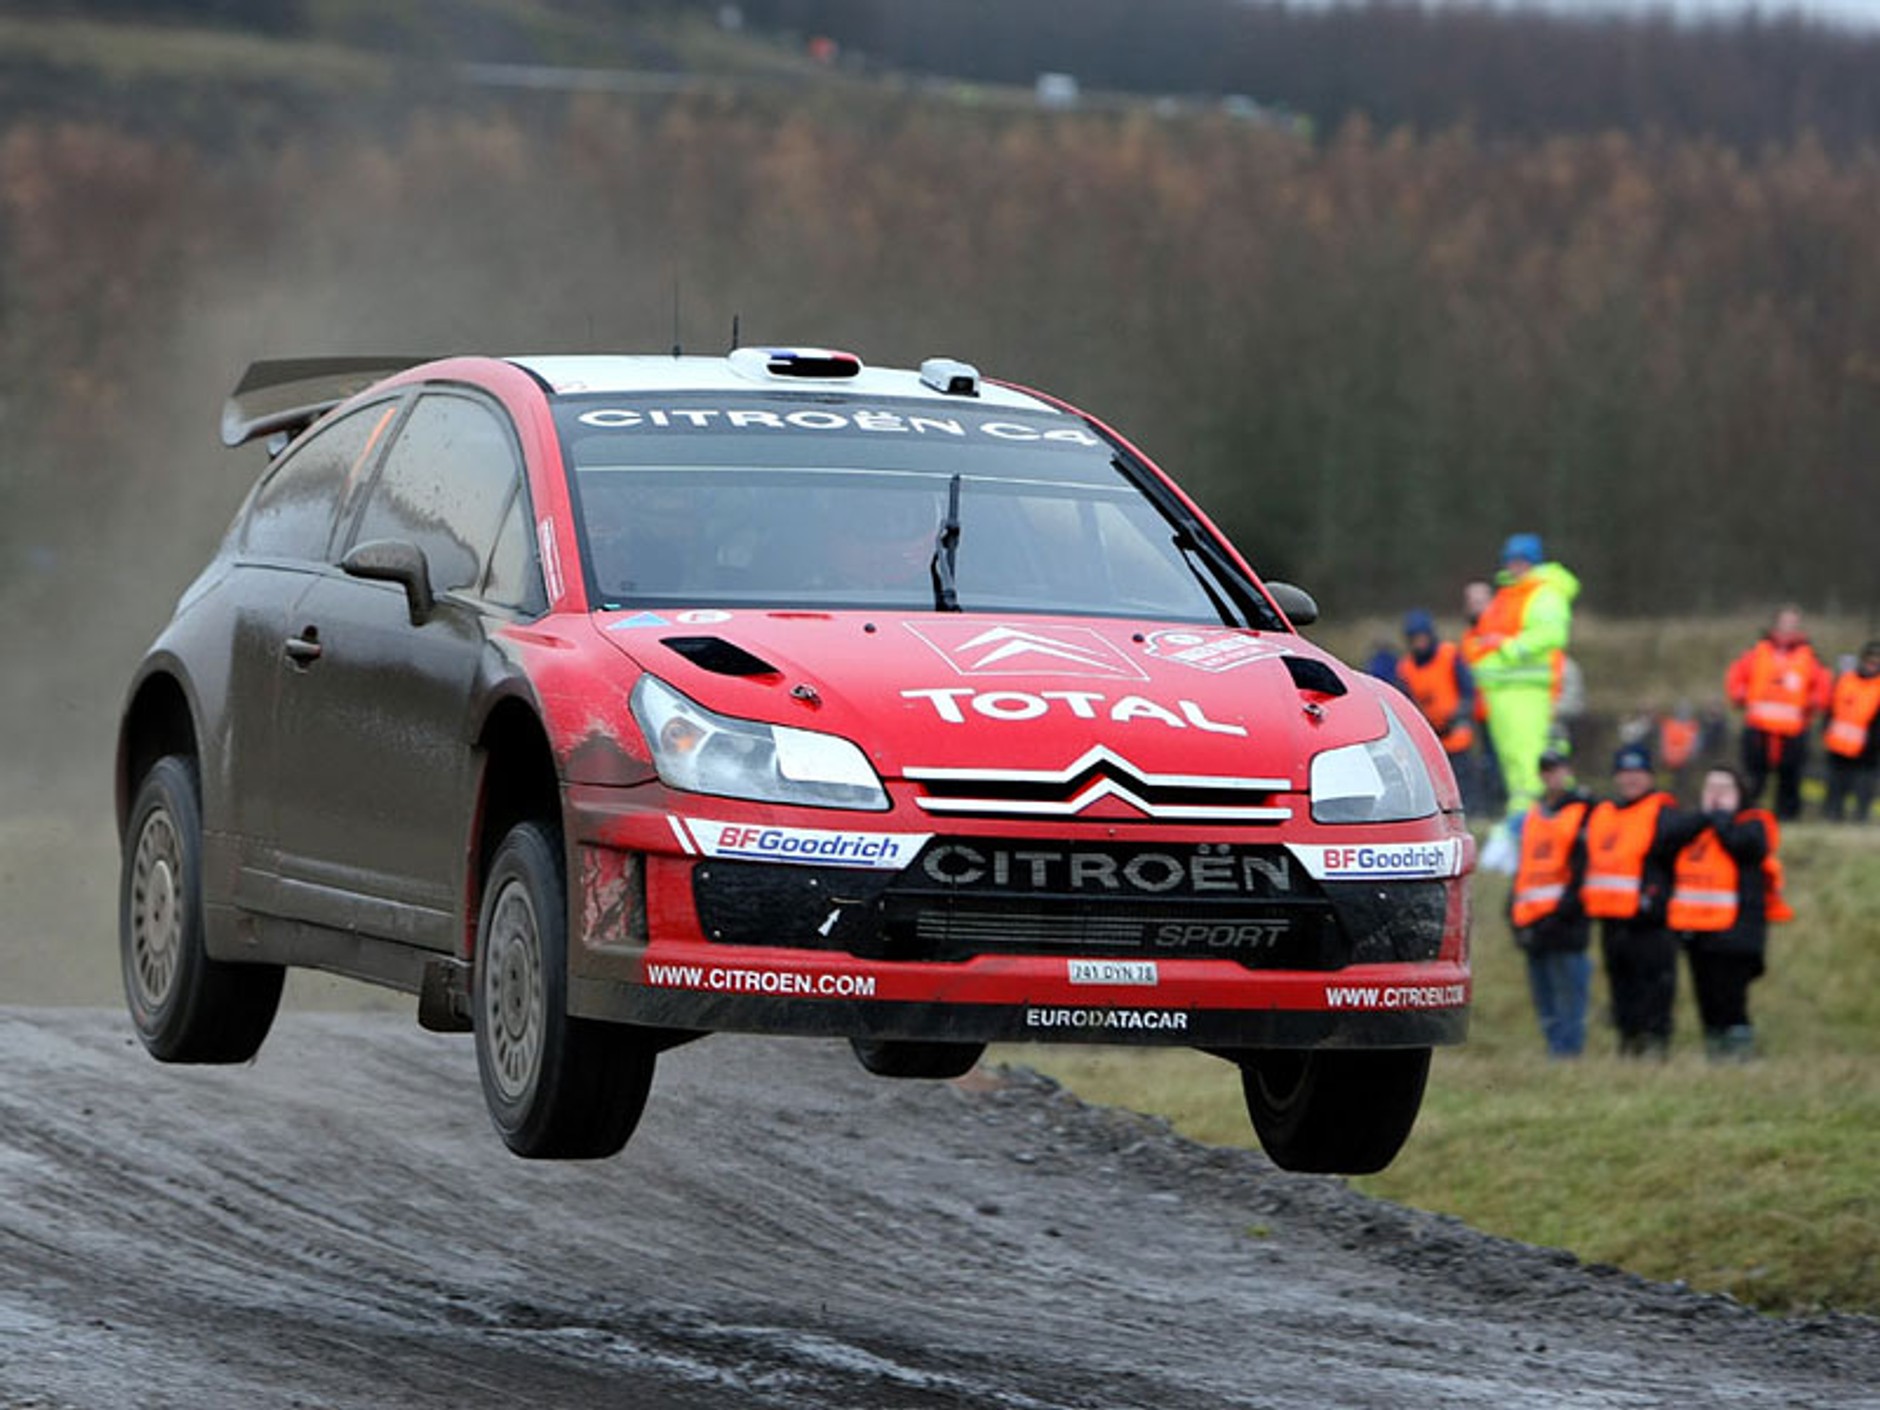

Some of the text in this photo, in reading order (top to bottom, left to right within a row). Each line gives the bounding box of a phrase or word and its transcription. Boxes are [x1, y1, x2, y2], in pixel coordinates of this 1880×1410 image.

[578, 409, 1098, 447] CITROËN C4
[900, 688, 1249, 737] TOTAL
[717, 826, 899, 858] BFGoodrich
[1323, 847, 1445, 869] BFGoodrich
[922, 844, 1292, 892] CITROËN
[1154, 925, 1290, 948] SPORT
[647, 964, 876, 996] WWW.CITROEN.COM
[1026, 1008, 1188, 1029] EURODATACAR
